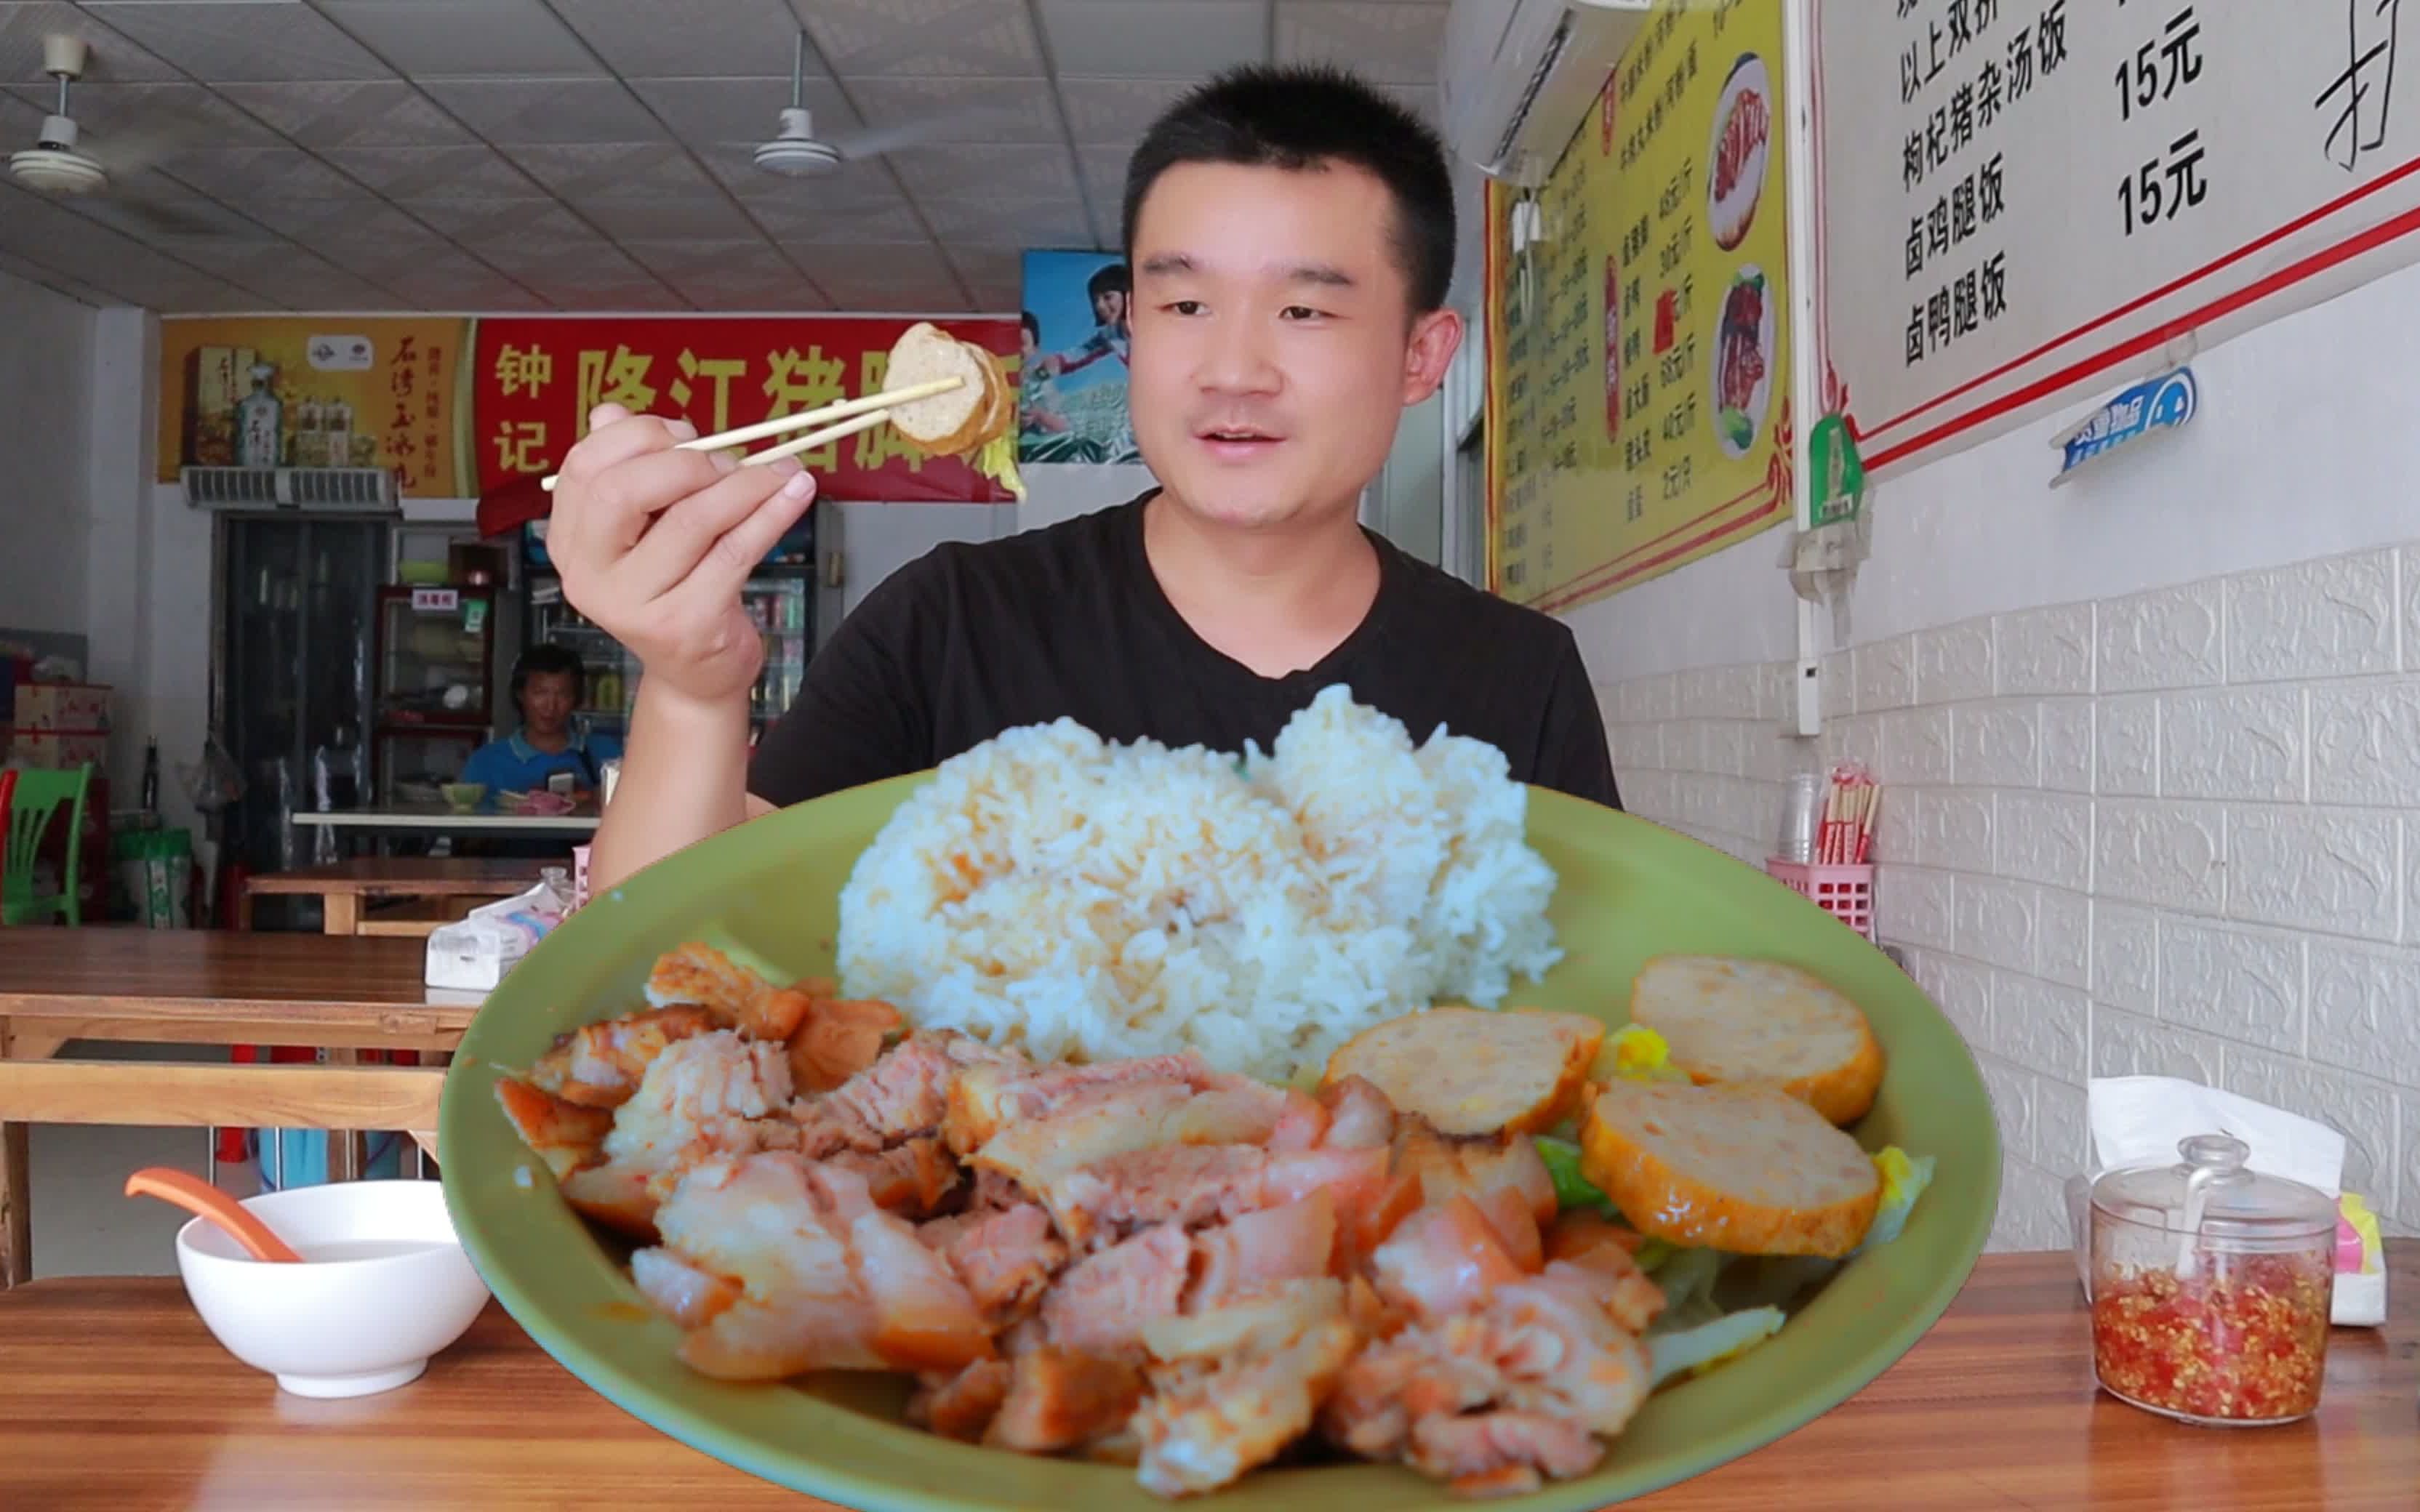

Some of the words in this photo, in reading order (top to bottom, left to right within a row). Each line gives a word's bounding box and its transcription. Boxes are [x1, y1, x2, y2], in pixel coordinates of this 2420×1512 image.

[1902, 0, 2067, 193] 枸杞猪杂汤饭
[1905, 150, 2006, 281] 卤鸡腿饭
[2115, 4, 2203, 122] 15元
[1906, 249, 2007, 369] 卤鸭腿饭
[2118, 128, 2208, 238] 15元
[493, 342, 553, 475] 钟记
